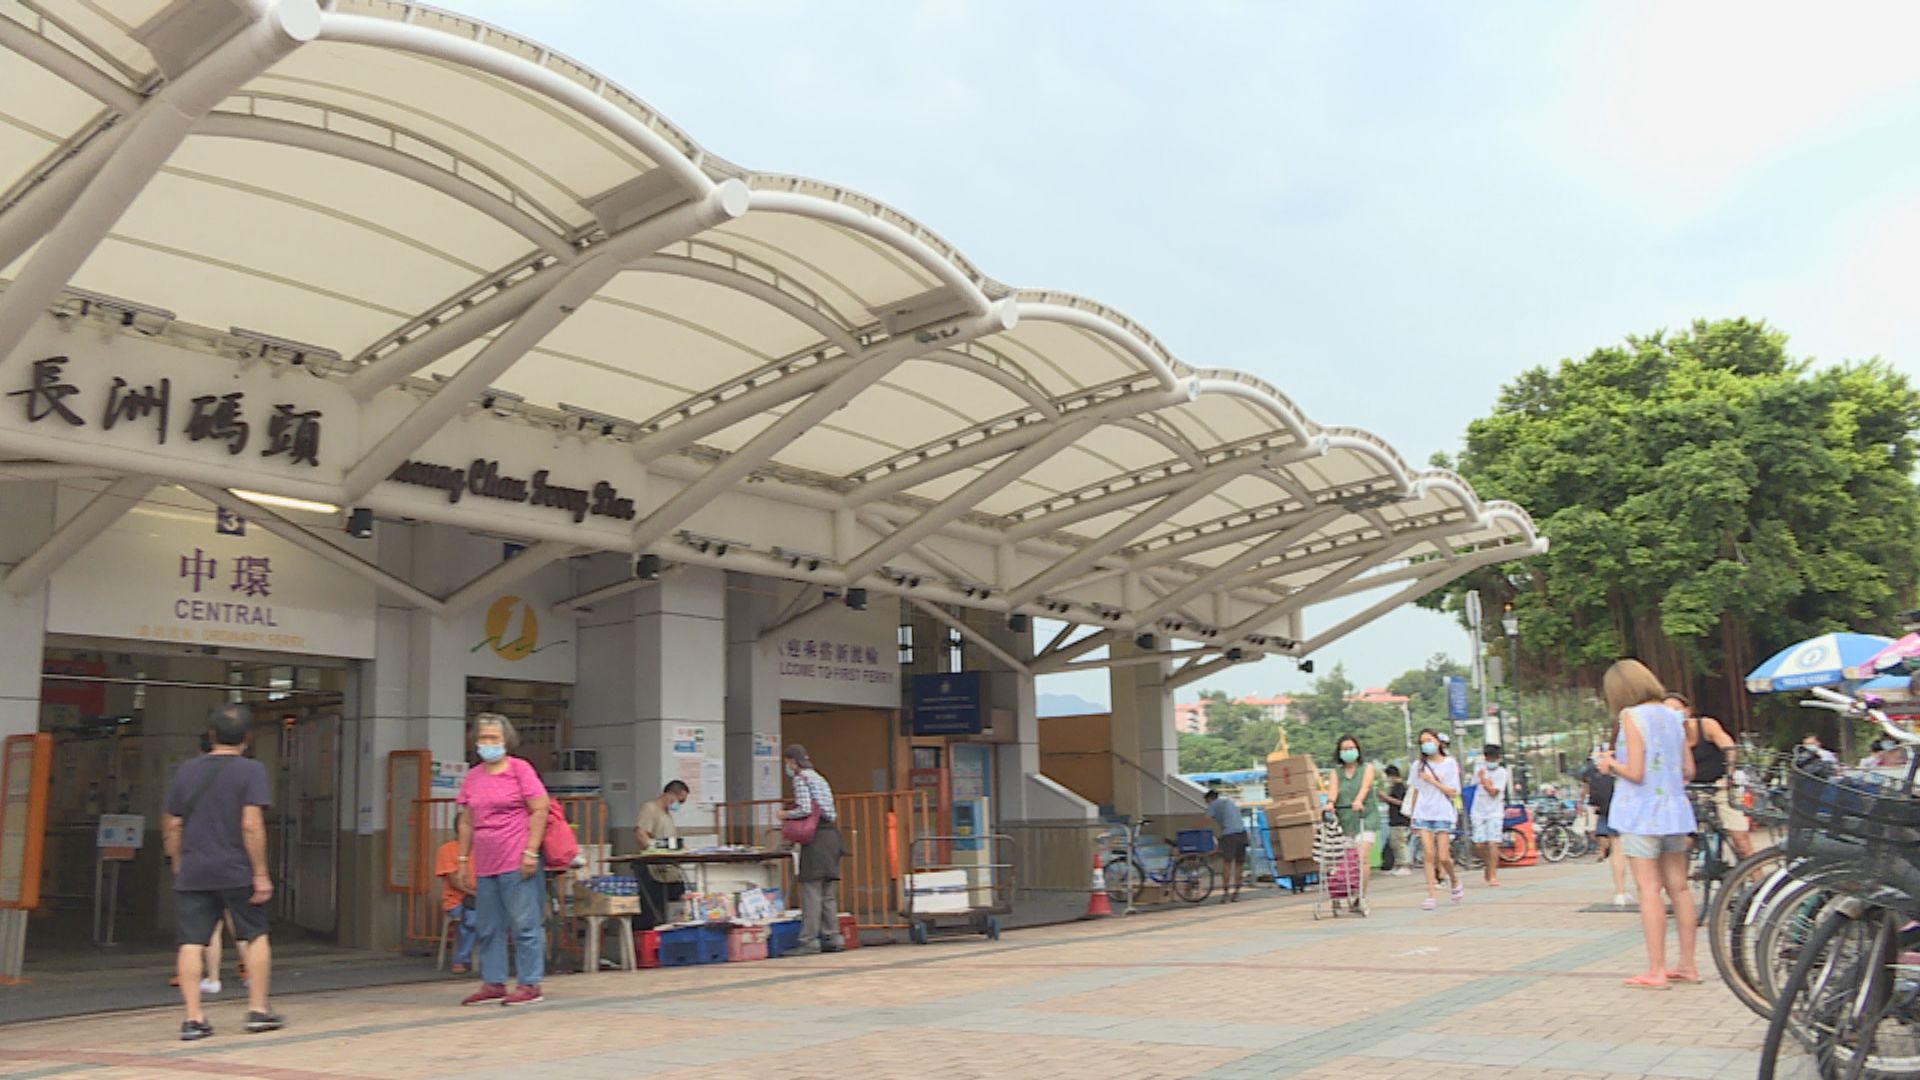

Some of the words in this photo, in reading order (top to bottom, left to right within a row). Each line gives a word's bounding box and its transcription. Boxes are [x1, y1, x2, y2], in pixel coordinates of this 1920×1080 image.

[6, 356, 323, 467] 長洲碼頭
[468, 458, 529, 503] Chau
[223, 510, 240, 532] 3
[179, 548, 273, 597] 中環
[174, 599, 278, 627] CENTRAL
